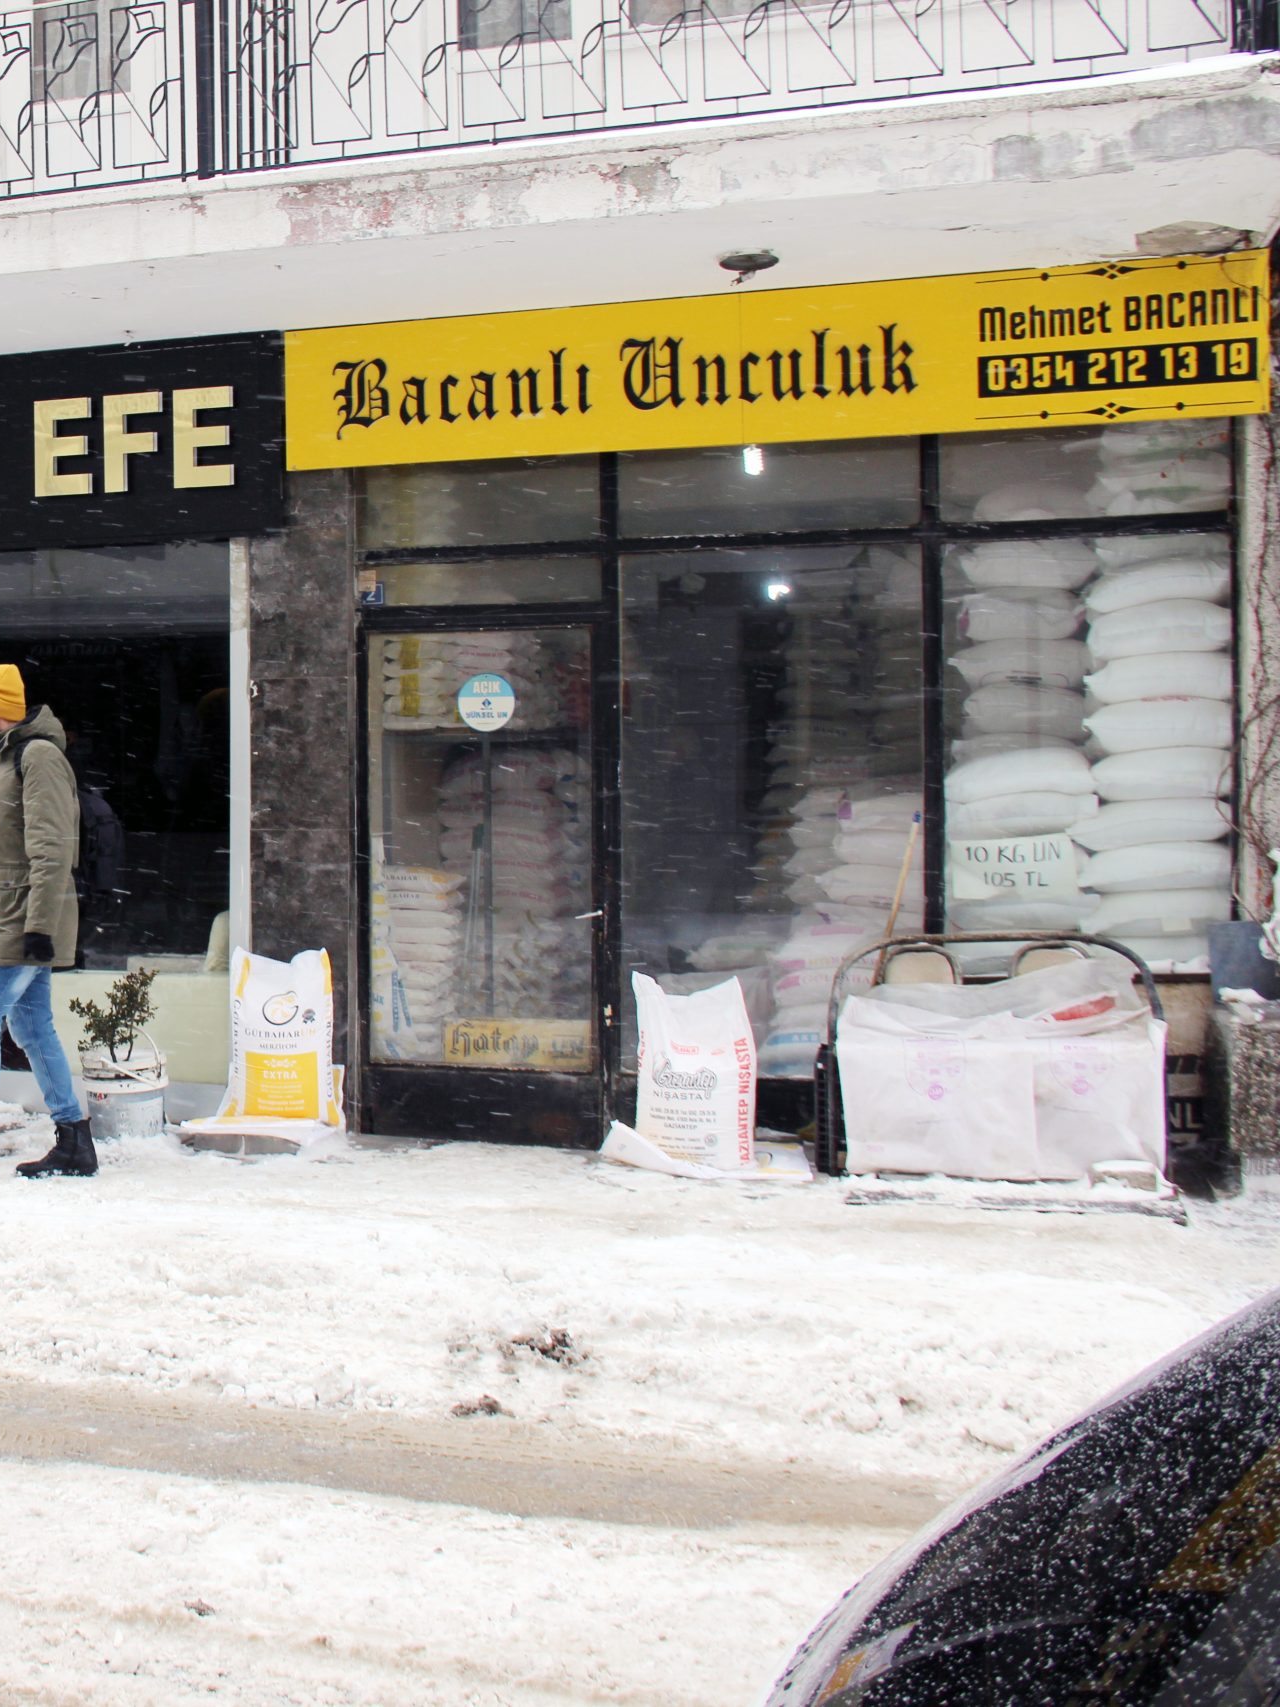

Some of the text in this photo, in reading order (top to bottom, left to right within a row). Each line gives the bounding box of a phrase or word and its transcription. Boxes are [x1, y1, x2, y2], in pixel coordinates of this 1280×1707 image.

[979, 285, 1259, 342] Mehmet BACANLI
[332, 322, 919, 440] Bacanlı Unculuk
[987, 342, 1250, 391] 0354 212 13 19
[34, 385, 235, 498] EFE
[965, 841, 1061, 864] 10 KG UN
[983, 871, 1049, 888] 105 TL
[263, 1070, 298, 1080] EXTRA
